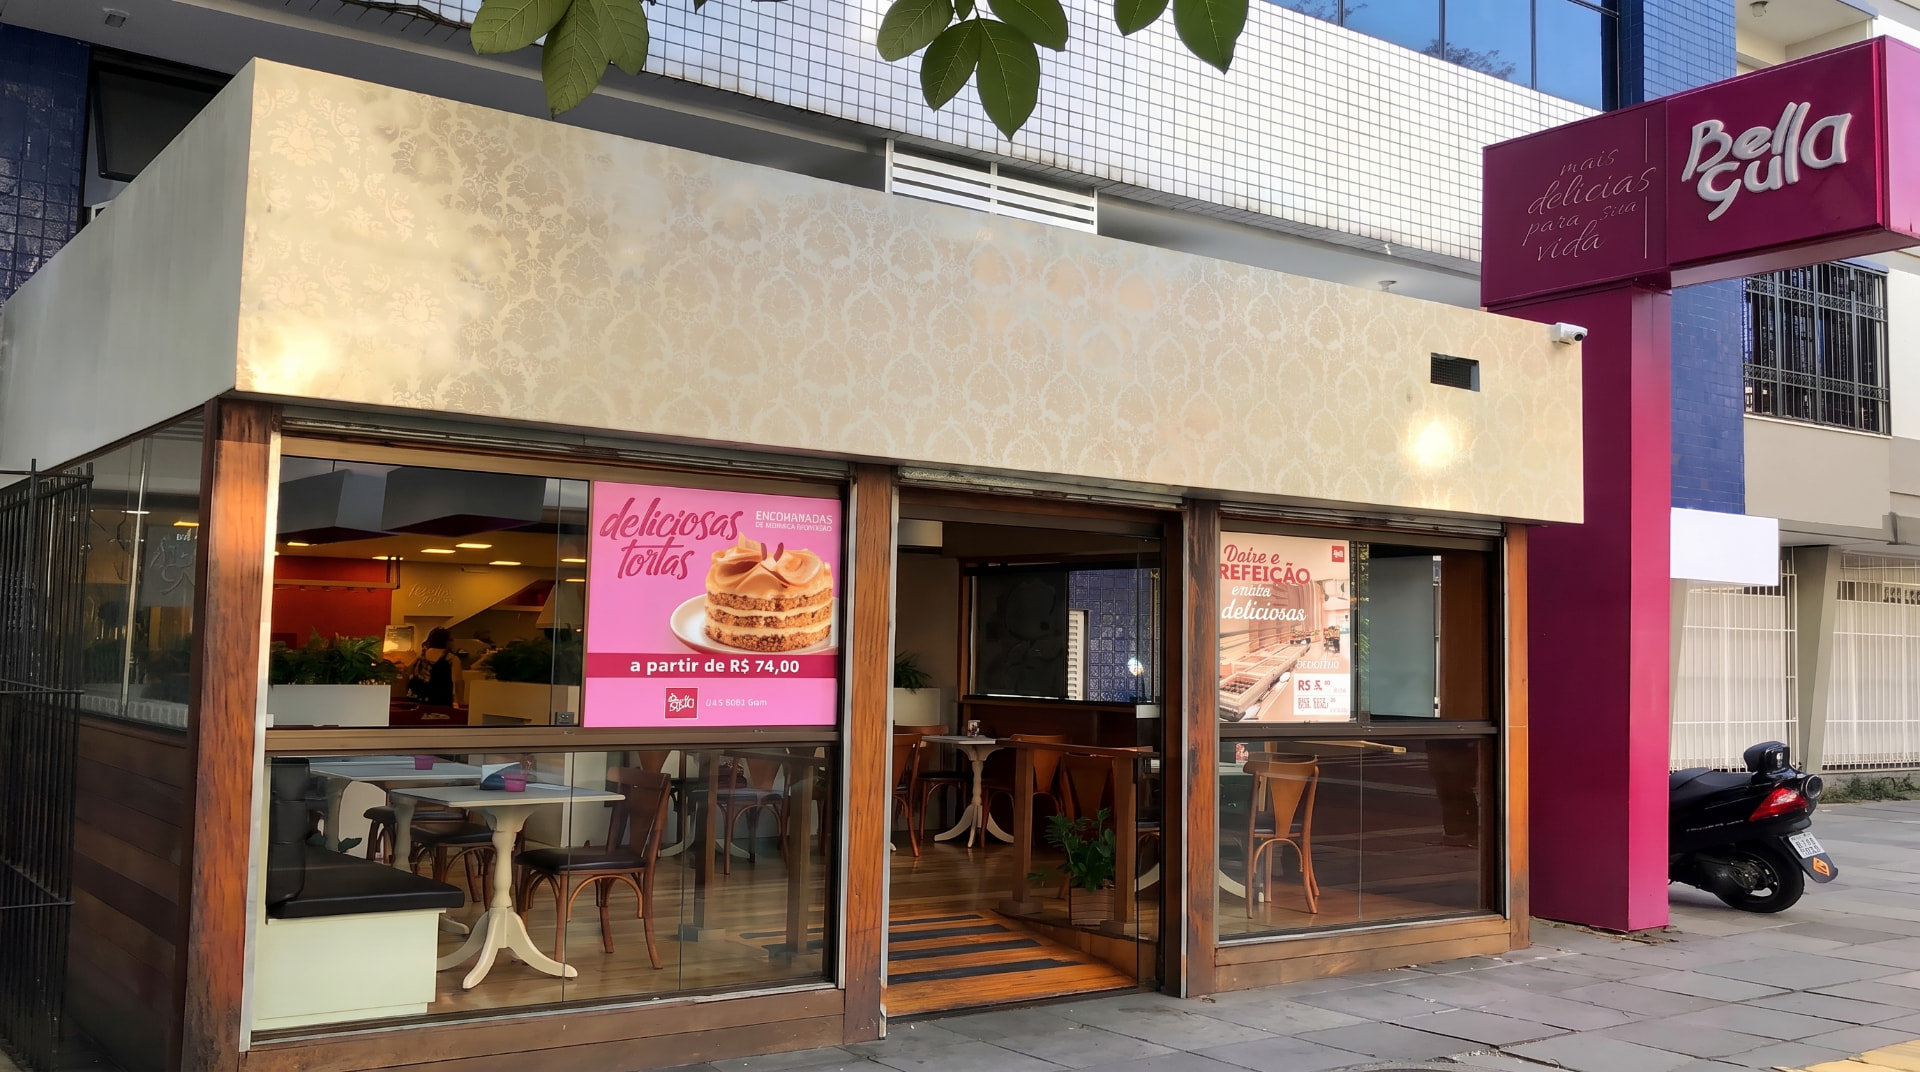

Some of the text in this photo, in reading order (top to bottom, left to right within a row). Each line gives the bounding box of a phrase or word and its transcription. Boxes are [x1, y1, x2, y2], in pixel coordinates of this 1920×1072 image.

[1681, 101, 1853, 185] Bella
[1559, 148, 1619, 176] mais
[1527, 166, 1657, 216] delicias
[1522, 213, 1581, 247] para
[1537, 219, 1605, 262] vida
[600, 497, 744, 541] deliciosas
[617, 536, 695, 580] tortas
[1220, 562, 1311, 585] REFEIÇÃO
[1270, 553, 1281, 565] e
[1221, 598, 1307, 621] deliciosas
[630, 657, 800, 676] a partir de R$ 74,00
